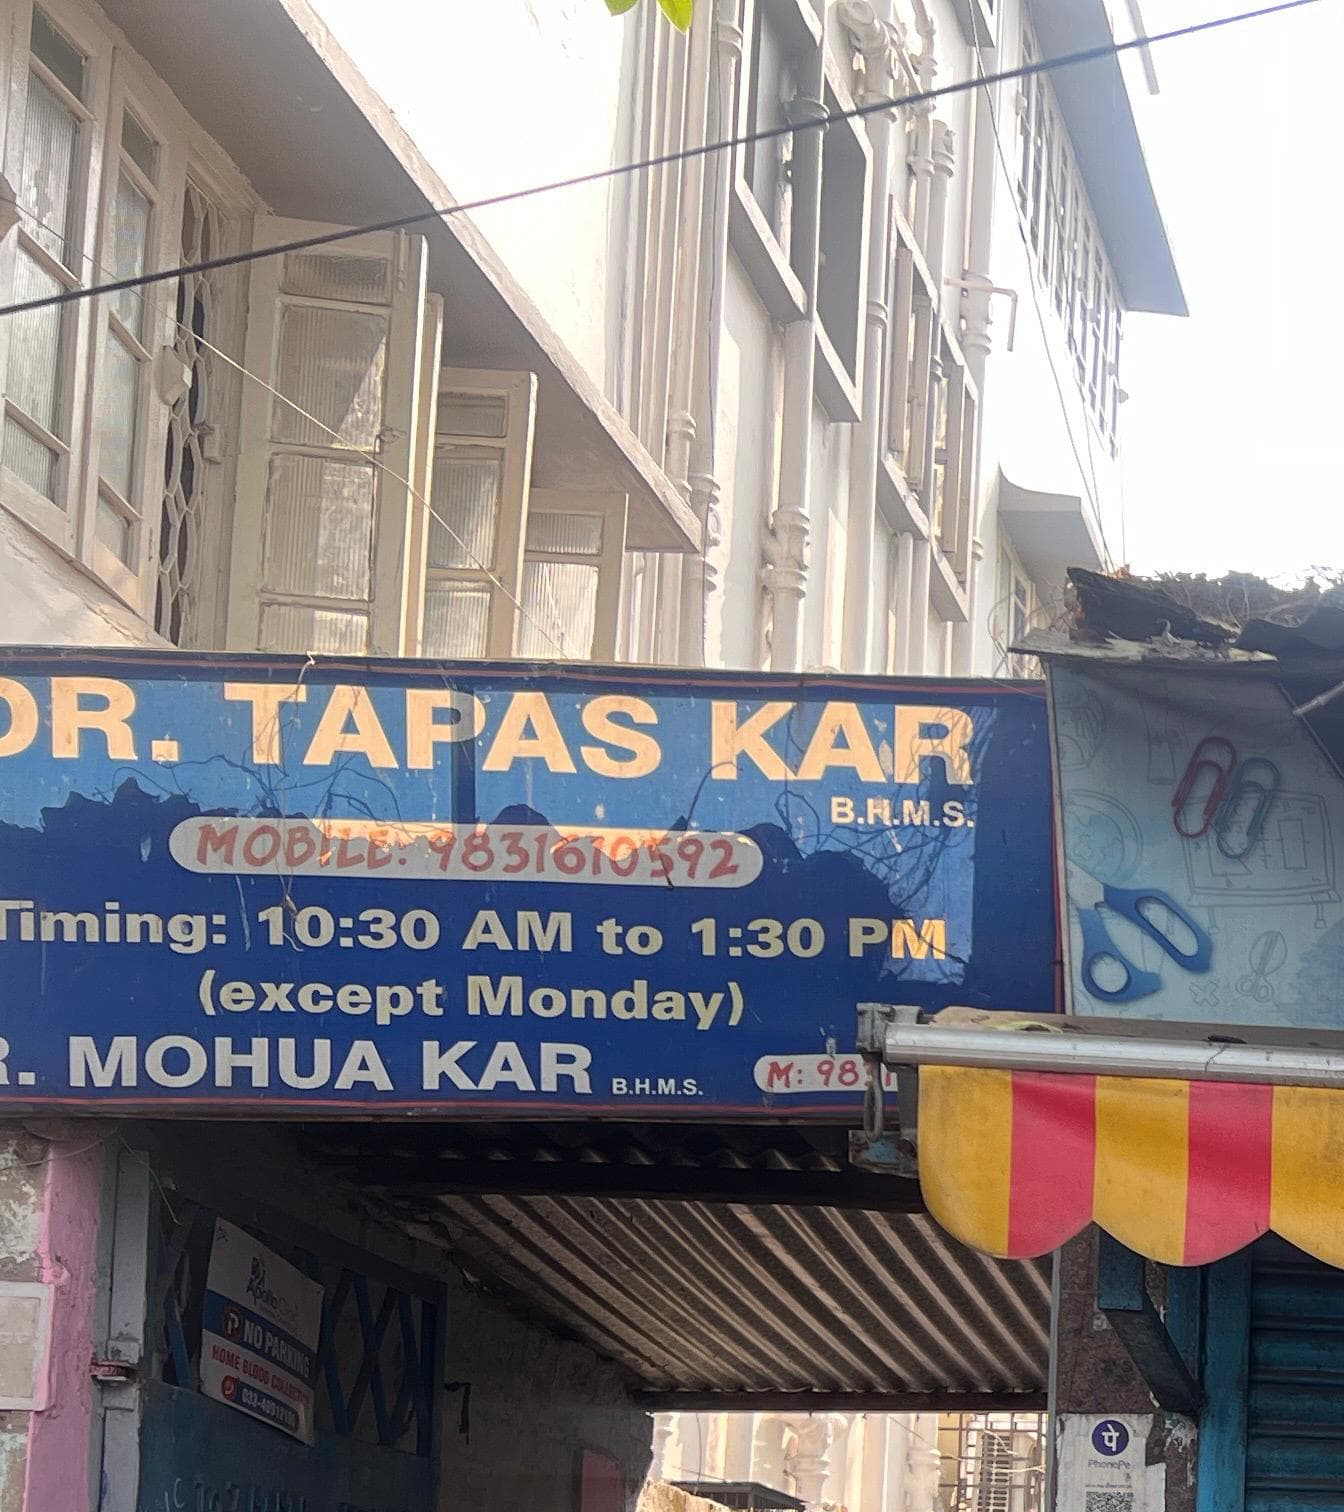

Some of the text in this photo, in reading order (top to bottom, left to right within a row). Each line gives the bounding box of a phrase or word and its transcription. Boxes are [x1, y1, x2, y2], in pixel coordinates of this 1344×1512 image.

[225, 684, 662, 776] TAPAS
[711, 699, 973, 785] KAR
[830, 795, 974, 829] B.H.M.S.
[198, 823, 408, 871] MOBILE:
[256, 905, 438, 952] 10:30
[462, 910, 572, 953] AM
[598, 917, 663, 958] to
[690, 918, 822, 958] 1:30
[849, 919, 947, 960] PM
[199, 968, 744, 1028] (except Monday)
[69, 1036, 395, 1090] MOHUA
[421, 1041, 593, 1094] KAR
[611, 1076, 703, 1096] B.H.M.S.
[212, 1344, 241, 1370] HOME
[244, 1320, 263, 1349] NO
[1088, 1458, 1132, 1470] PhonePe
